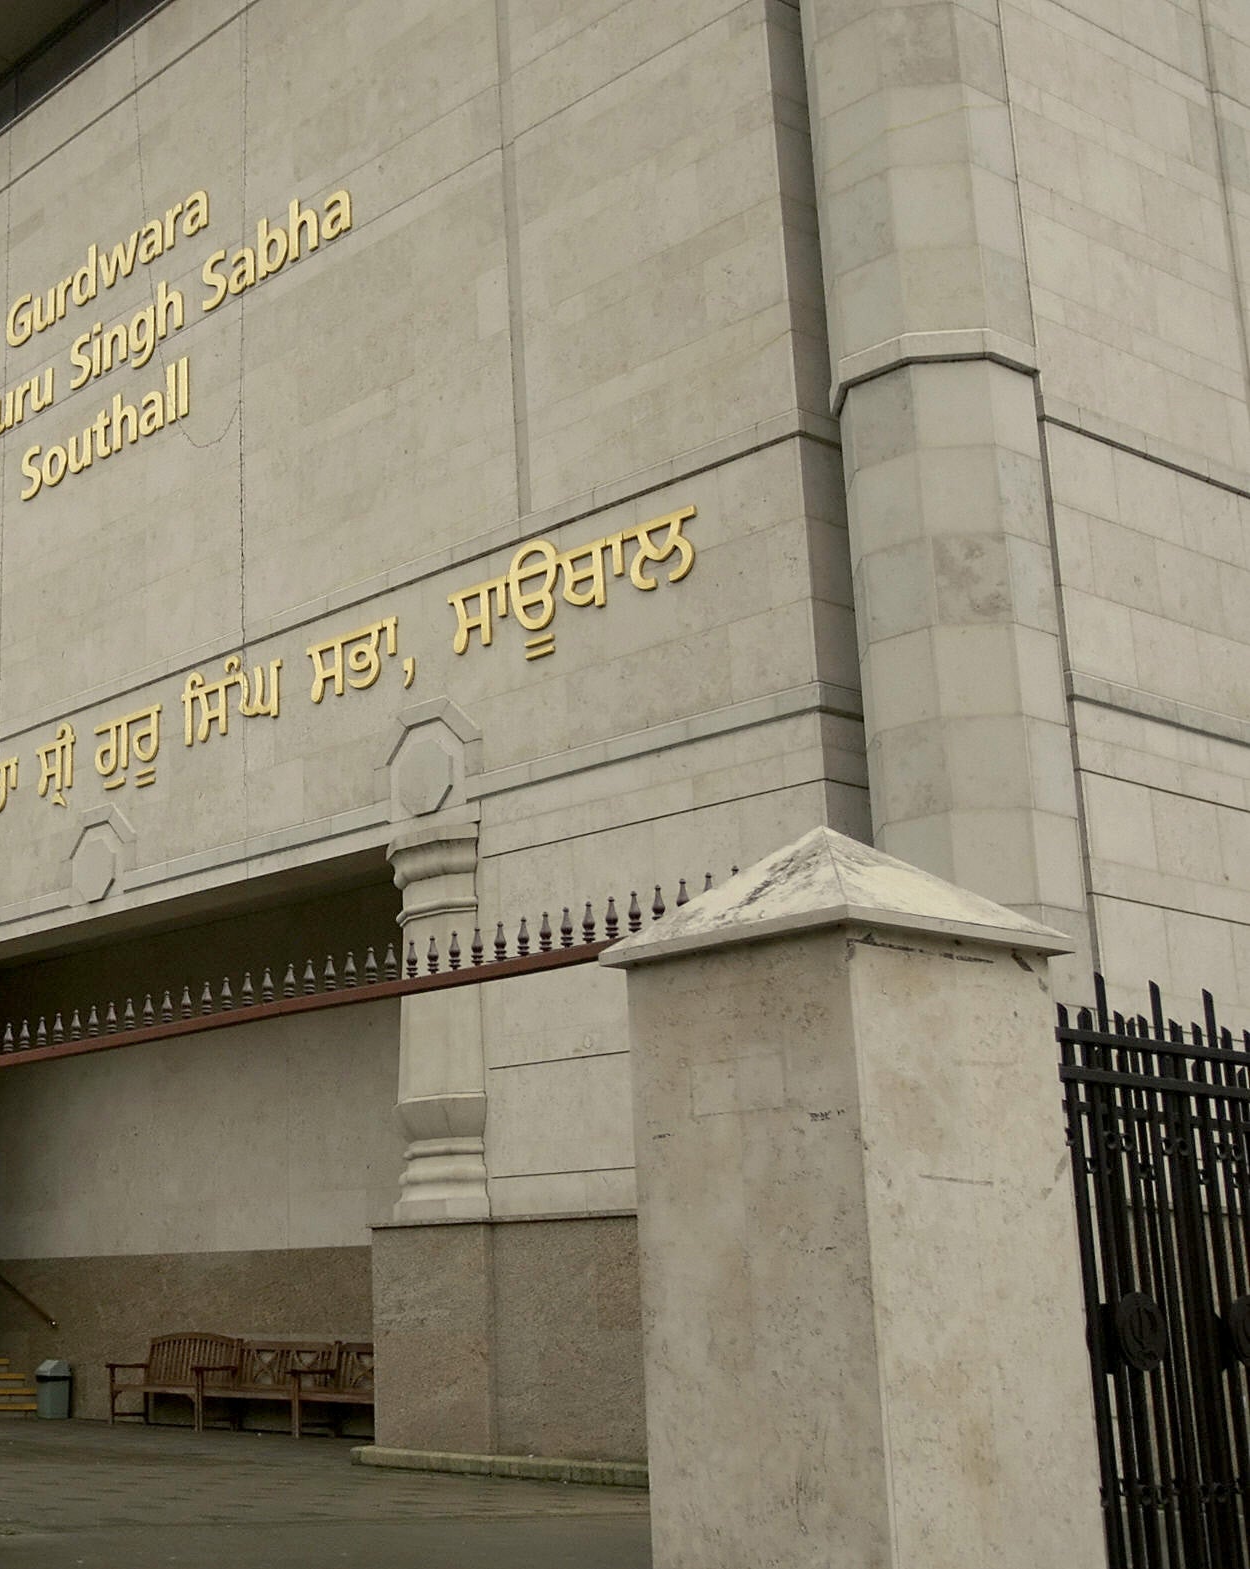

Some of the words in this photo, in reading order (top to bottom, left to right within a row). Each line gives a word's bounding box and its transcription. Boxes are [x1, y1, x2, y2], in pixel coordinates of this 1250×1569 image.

[6, 190, 210, 348] Gurdwara
[70, 280, 185, 391] Singh
[201, 189, 353, 311] Sabha
[20, 357, 190, 502] Southall
[36, 722, 76, 808] ਸ੍ਰੀ
[94, 704, 163, 790] ਗੁਰੂ
[181, 655, 283, 747] ਸਿੰਘ
[306, 615, 416, 705] ਸਭਾ,
